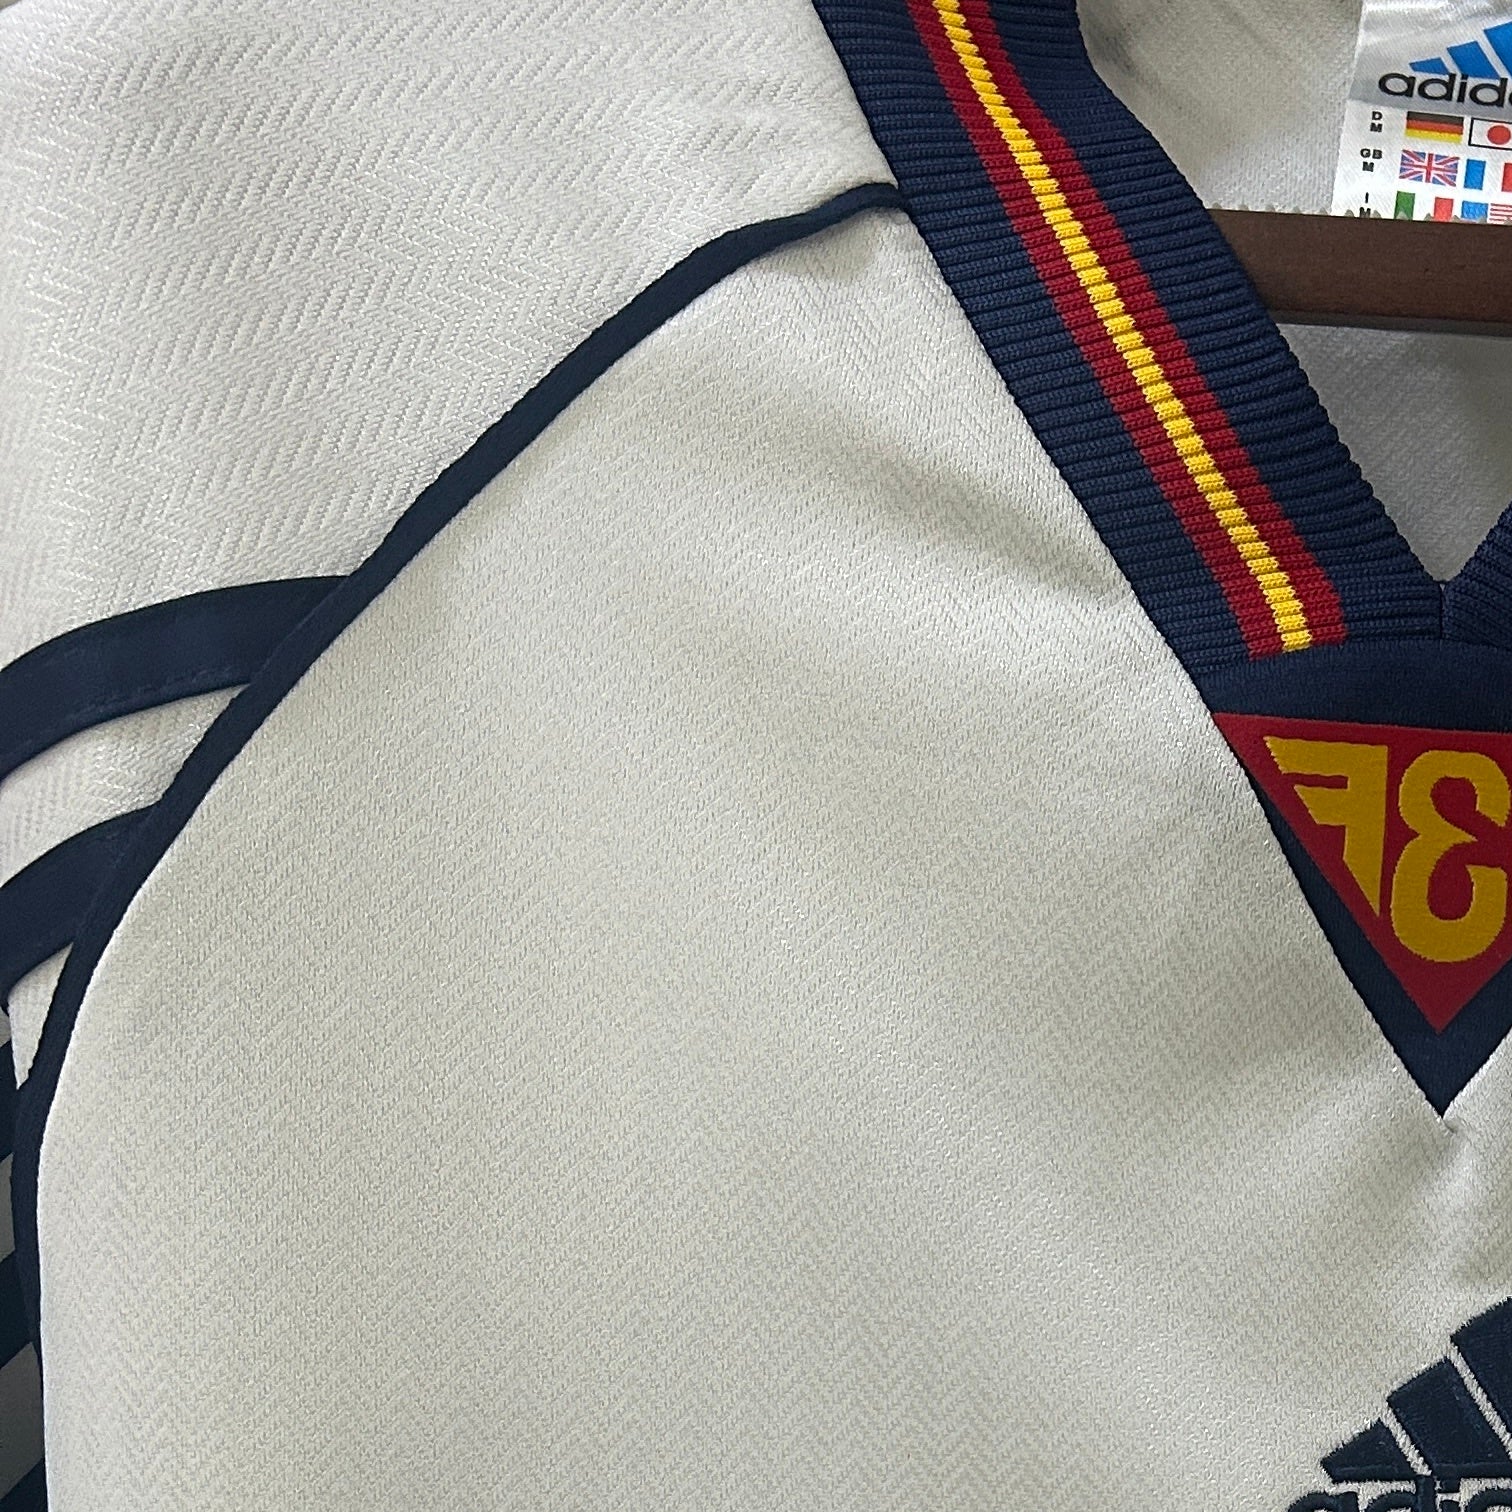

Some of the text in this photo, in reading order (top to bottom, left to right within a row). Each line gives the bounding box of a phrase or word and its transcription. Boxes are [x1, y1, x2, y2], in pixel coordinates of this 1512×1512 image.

[1371, 110, 1383, 120] D
[1369, 122, 1383, 133] M
[1360, 147, 1383, 160] GB
[1362, 161, 1375, 172] M
